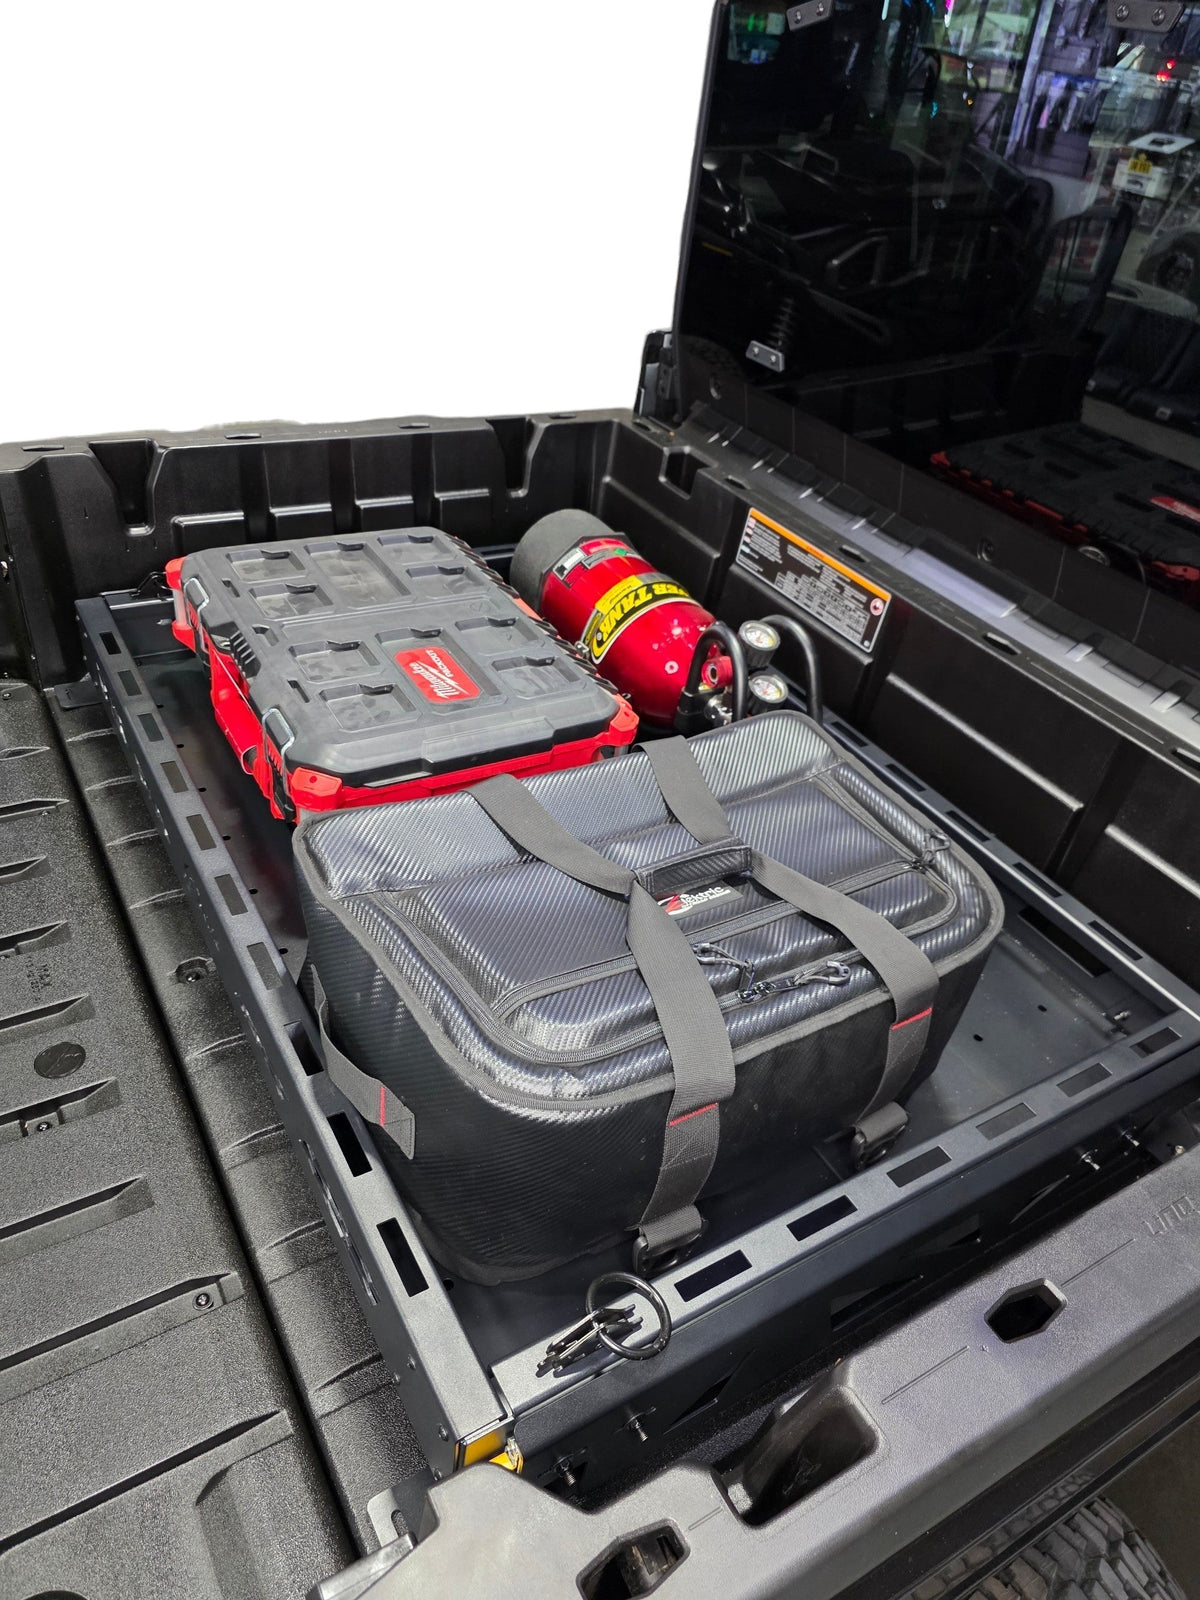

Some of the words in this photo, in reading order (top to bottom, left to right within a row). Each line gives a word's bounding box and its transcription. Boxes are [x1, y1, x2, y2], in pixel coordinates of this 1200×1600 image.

[599, 586, 653, 642] TANK
[409, 661, 460, 699] Milwaukee
[425, 649, 454, 678] PACKOUT
